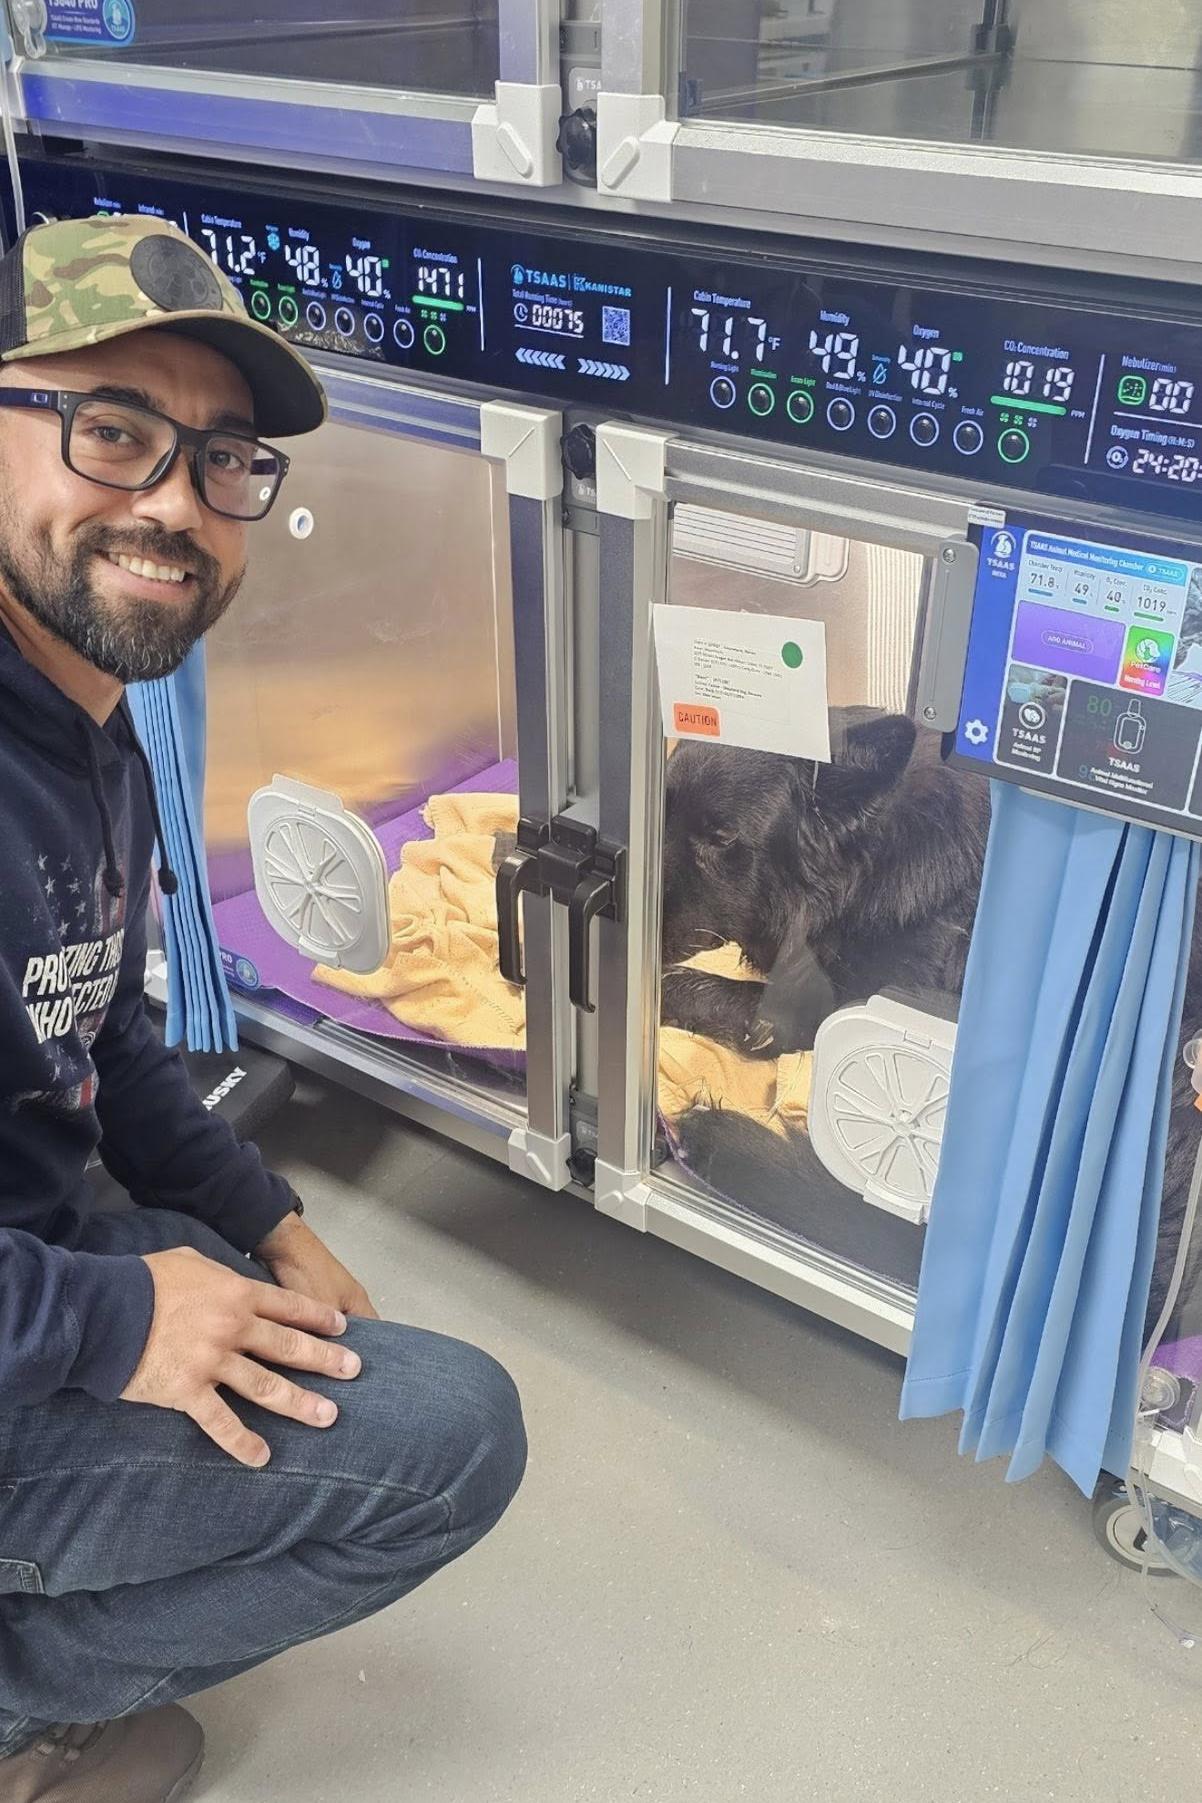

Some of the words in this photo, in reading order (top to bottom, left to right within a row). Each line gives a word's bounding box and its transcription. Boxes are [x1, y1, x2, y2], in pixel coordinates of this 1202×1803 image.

[418, 266, 464, 298] 1471
[526, 269, 567, 288] TSAAS
[585, 281, 632, 297] KANISTAR
[693, 290, 711, 302] Cabin
[711, 292, 751, 309] Temperature
[532, 304, 584, 334] 00075
[820, 310, 850, 327] Humidity
[691, 308, 767, 362] 71.7
[912, 324, 940, 339] Oxygen
[1017, 341, 1070, 360] Concentration
[1003, 360, 1075, 402] 1019
[1149, 377, 1195, 414] 00
[1110, 424, 1140, 440] Oxygen
[986, 556, 1016, 571] TSAAS
[1067, 548, 1089, 560] Medical
[1089, 552, 1118, 567] Monitoring
[1118, 558, 1145, 571] Chamber
[1030, 572, 1055, 588] 71.8
[1074, 583, 1090, 596] 49
[1106, 590, 1122, 603] 40
[1137, 595, 1167, 612] 1019
[678, 711, 717, 727] CAUTION
[1012, 727, 1047, 744] TSAAS
[1108, 756, 1141, 773] TSAAS
[202, 1066, 247, 1111] USKY
